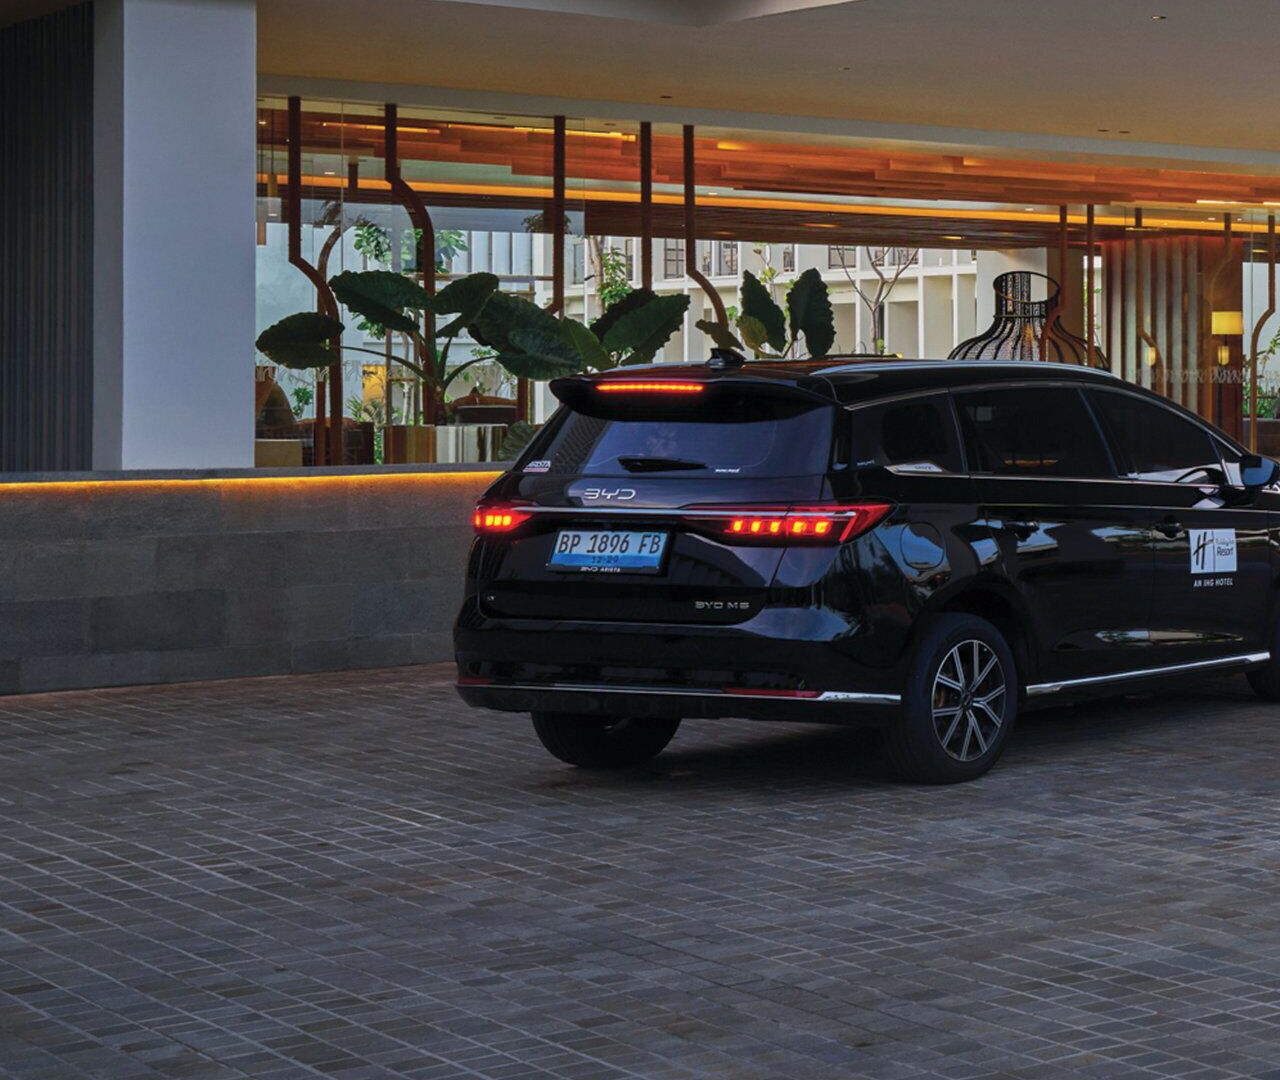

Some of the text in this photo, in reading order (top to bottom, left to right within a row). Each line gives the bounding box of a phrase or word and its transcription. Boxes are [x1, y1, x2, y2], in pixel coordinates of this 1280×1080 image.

[584, 488, 636, 500] BYD
[557, 534, 662, 554] BP 1896 FB
[1215, 578, 1233, 586] HOTEL
[695, 601, 723, 609] BYD
